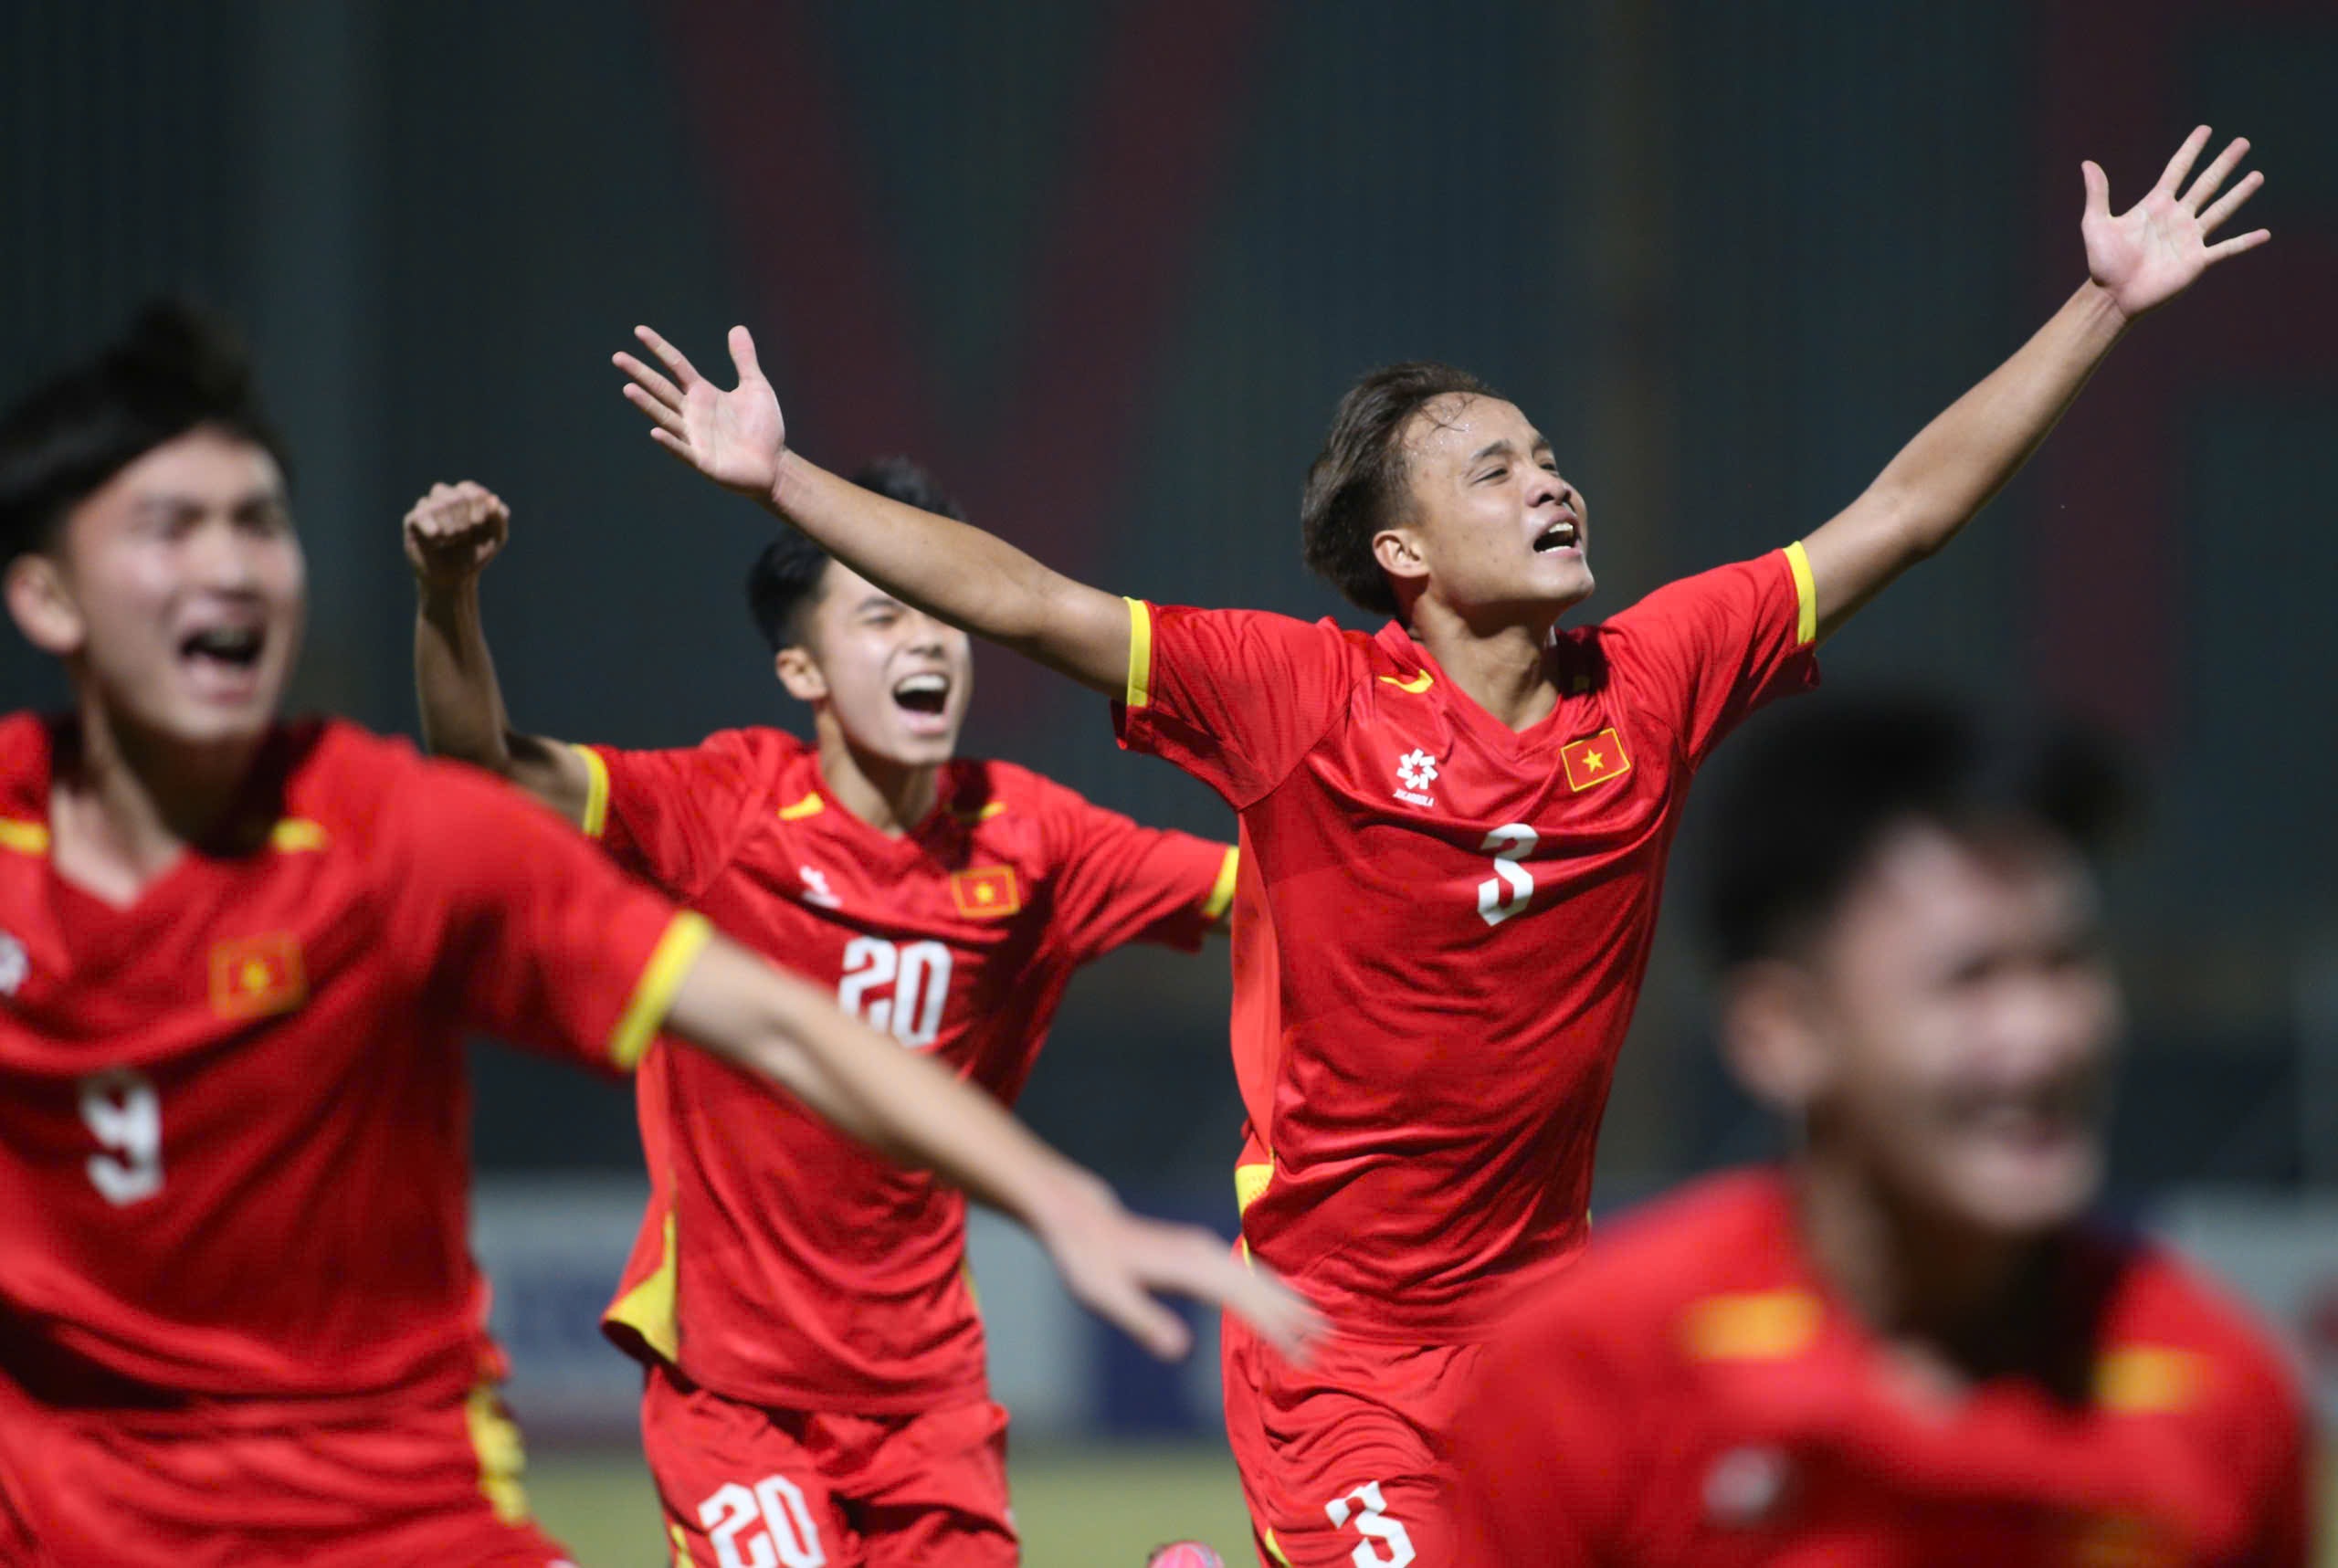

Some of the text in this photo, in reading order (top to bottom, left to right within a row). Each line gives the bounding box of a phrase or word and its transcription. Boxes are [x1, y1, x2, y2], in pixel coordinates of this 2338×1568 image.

[1478, 823, 1539, 927] 3
[838, 935, 953, 1047] 20
[79, 1068, 163, 1206] 9
[697, 1474, 826, 1568] 20
[1325, 1480, 1416, 1568] 3
